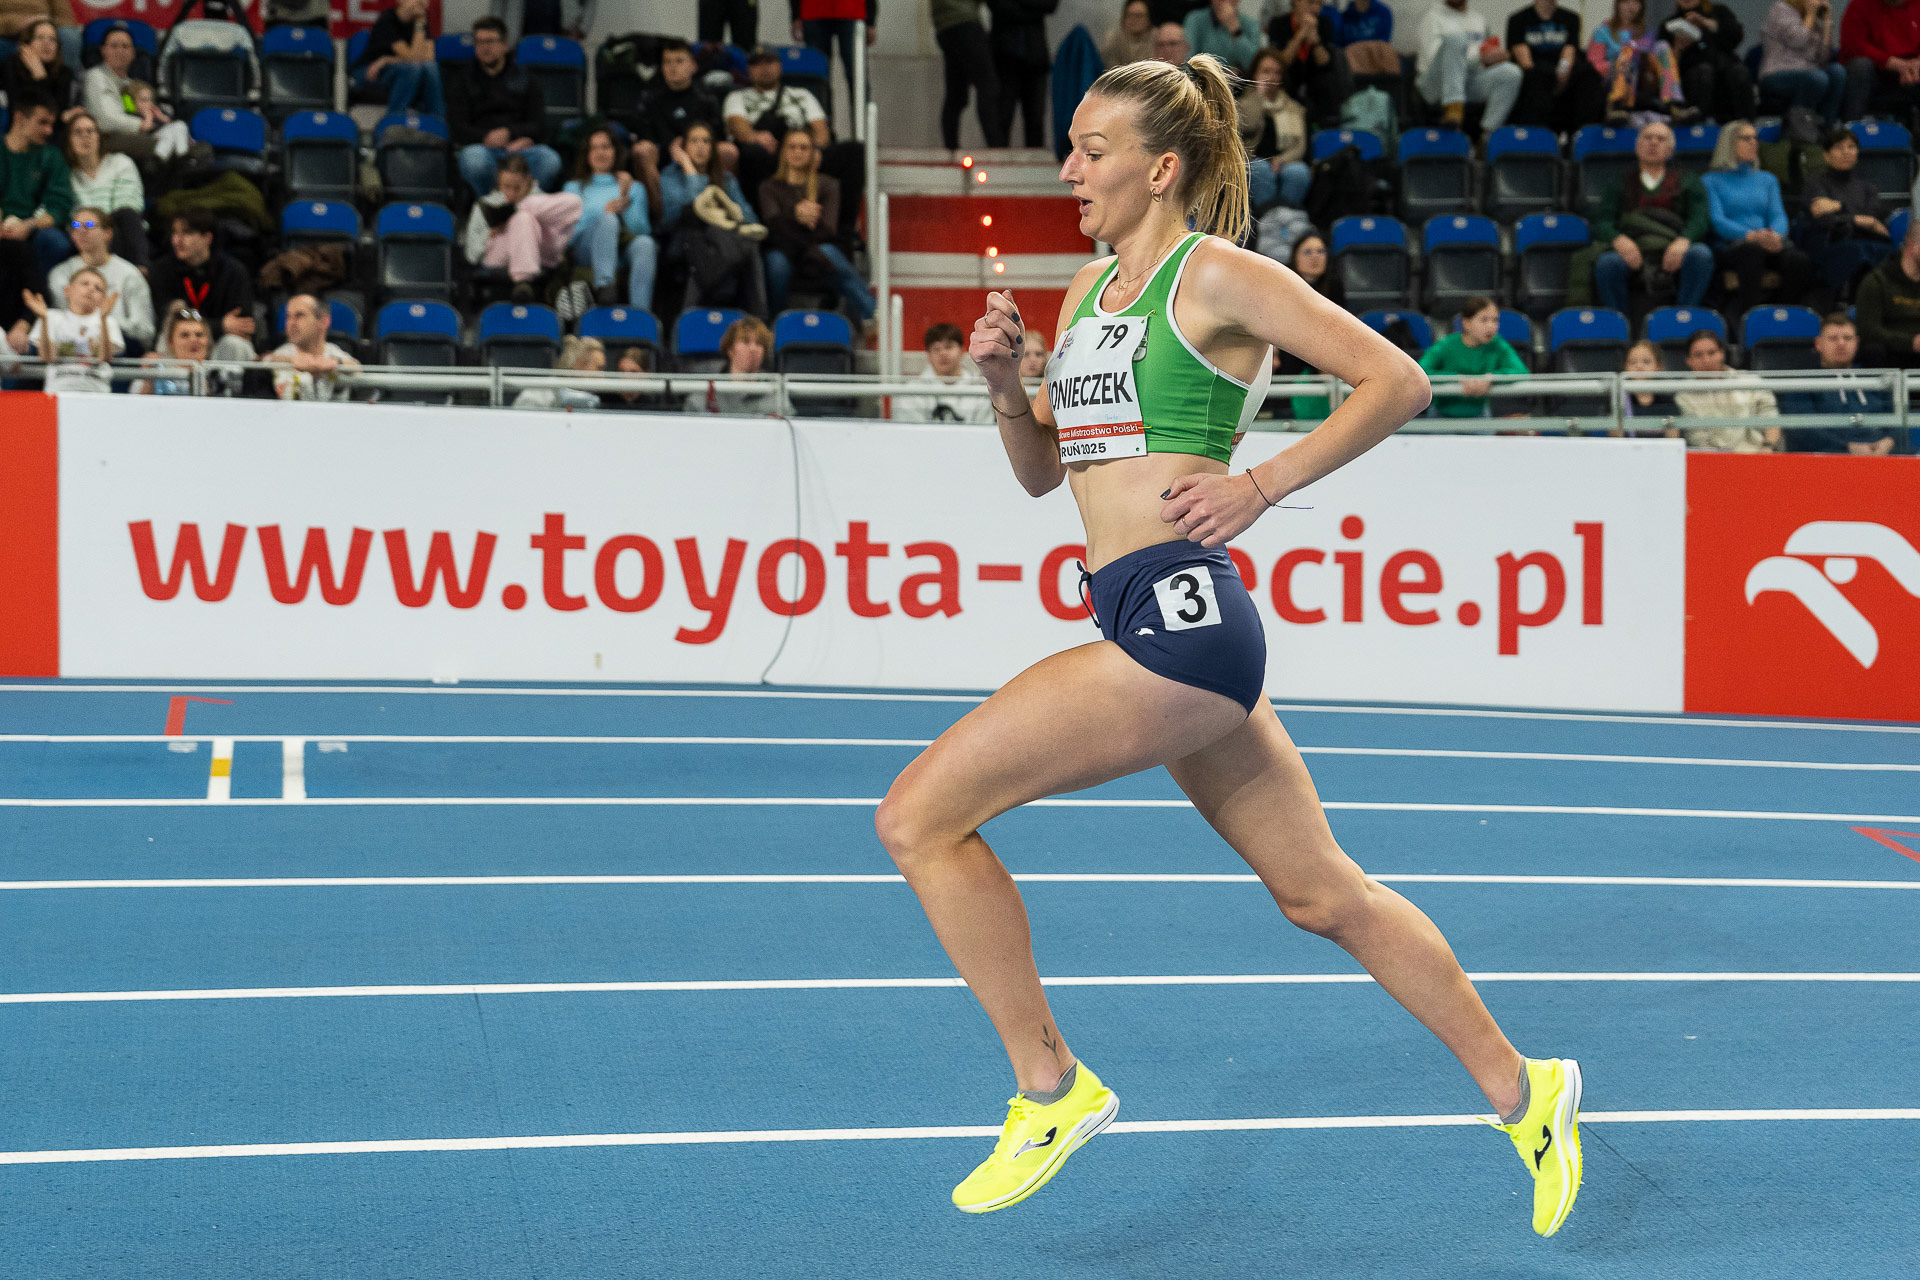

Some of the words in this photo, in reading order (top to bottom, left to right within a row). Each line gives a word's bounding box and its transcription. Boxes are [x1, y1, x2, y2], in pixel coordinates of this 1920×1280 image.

[1096, 324, 1129, 350] 79
[1071, 427, 1112, 438] Mistrzostwa
[1113, 423, 1139, 434] Polski
[1081, 442, 1107, 455] 2025
[1169, 573, 1207, 623] 3
